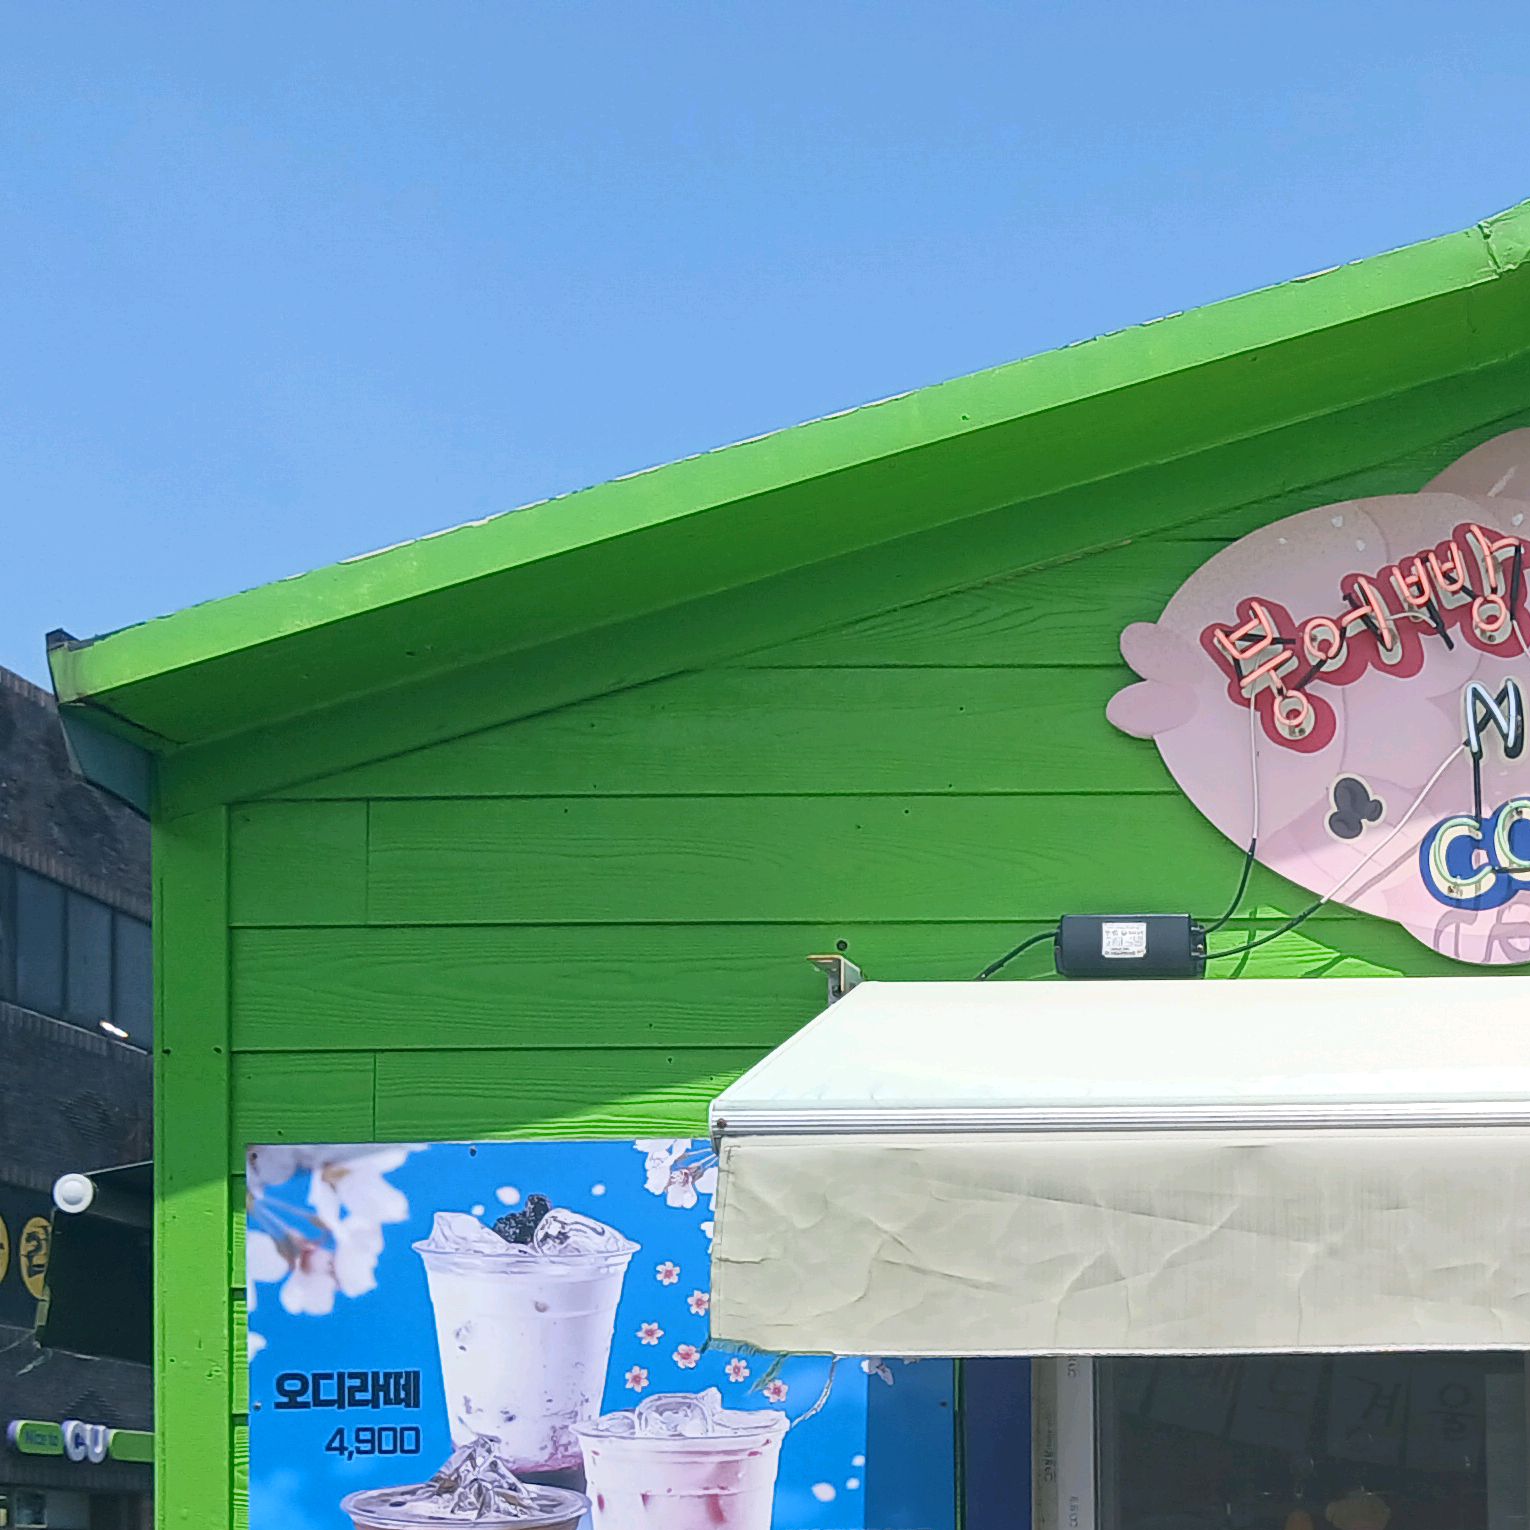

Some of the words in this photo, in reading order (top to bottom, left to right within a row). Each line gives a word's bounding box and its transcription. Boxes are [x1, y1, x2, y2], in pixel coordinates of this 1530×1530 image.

[1210, 522, 1528, 734] 붕어빵
[1464, 677, 1523, 761] N
[275, 1371, 421, 1409] 오디라떼
[63, 1420, 107, 1463] CU
[325, 1426, 421, 1458] 4,900
